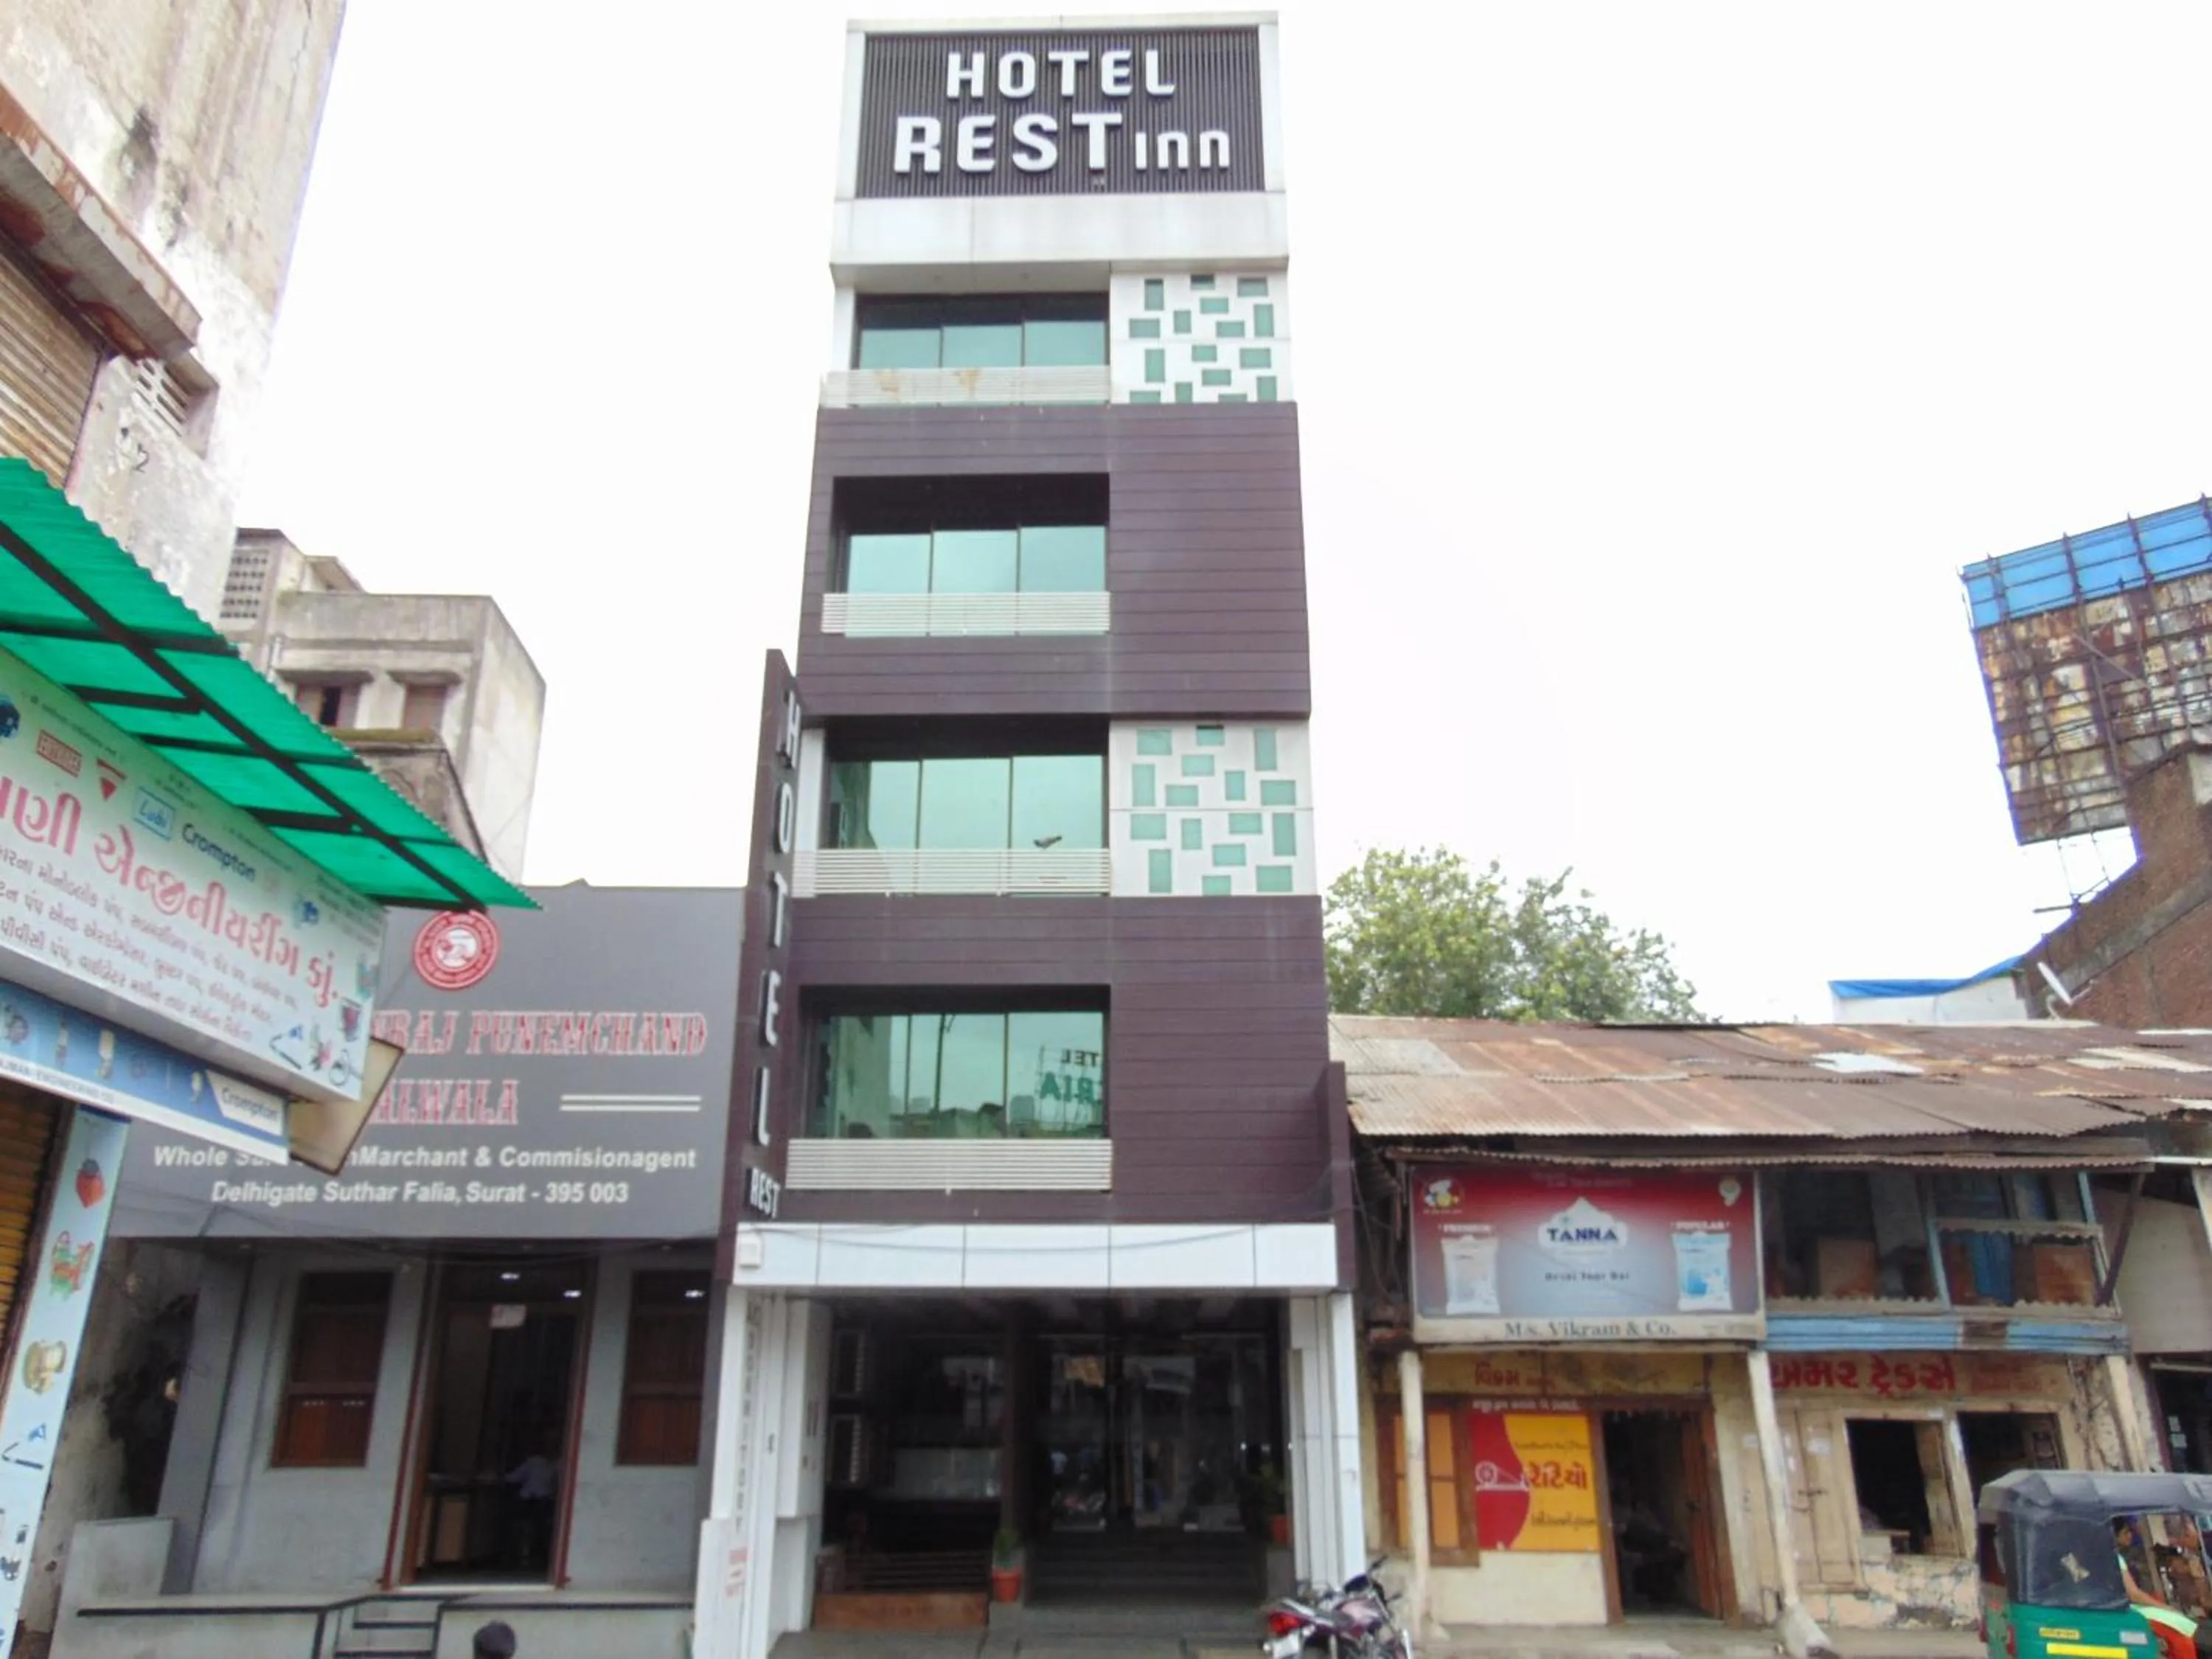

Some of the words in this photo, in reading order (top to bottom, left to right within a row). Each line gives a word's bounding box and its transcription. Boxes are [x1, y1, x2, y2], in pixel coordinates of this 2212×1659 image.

[946, 49, 1176, 100] HOTEL
[893, 112, 1123, 174] REST
[181, 823, 257, 883] Crompton
[221, 1086, 278, 1122] Crompton
[154, 1145, 228, 1167] Whole
[474, 1145, 492, 1169] &
[498, 1146, 697, 1173] Commisionagent
[211, 1181, 318, 1208] Delhigate
[322, 1181, 397, 1203] Suthar
[402, 1181, 462, 1206] Falia,
[465, 1181, 527, 1204] Surat
[544, 1182, 585, 1204] 395
[588, 1182, 630, 1204] 003
[748, 1166, 782, 1219] REST
[1546, 1227, 1618, 1242] TANNA
[1548, 1320, 1621, 1338] Vikram
[1625, 1321, 1640, 1337] &
[1646, 1322, 1677, 1337] Co.
